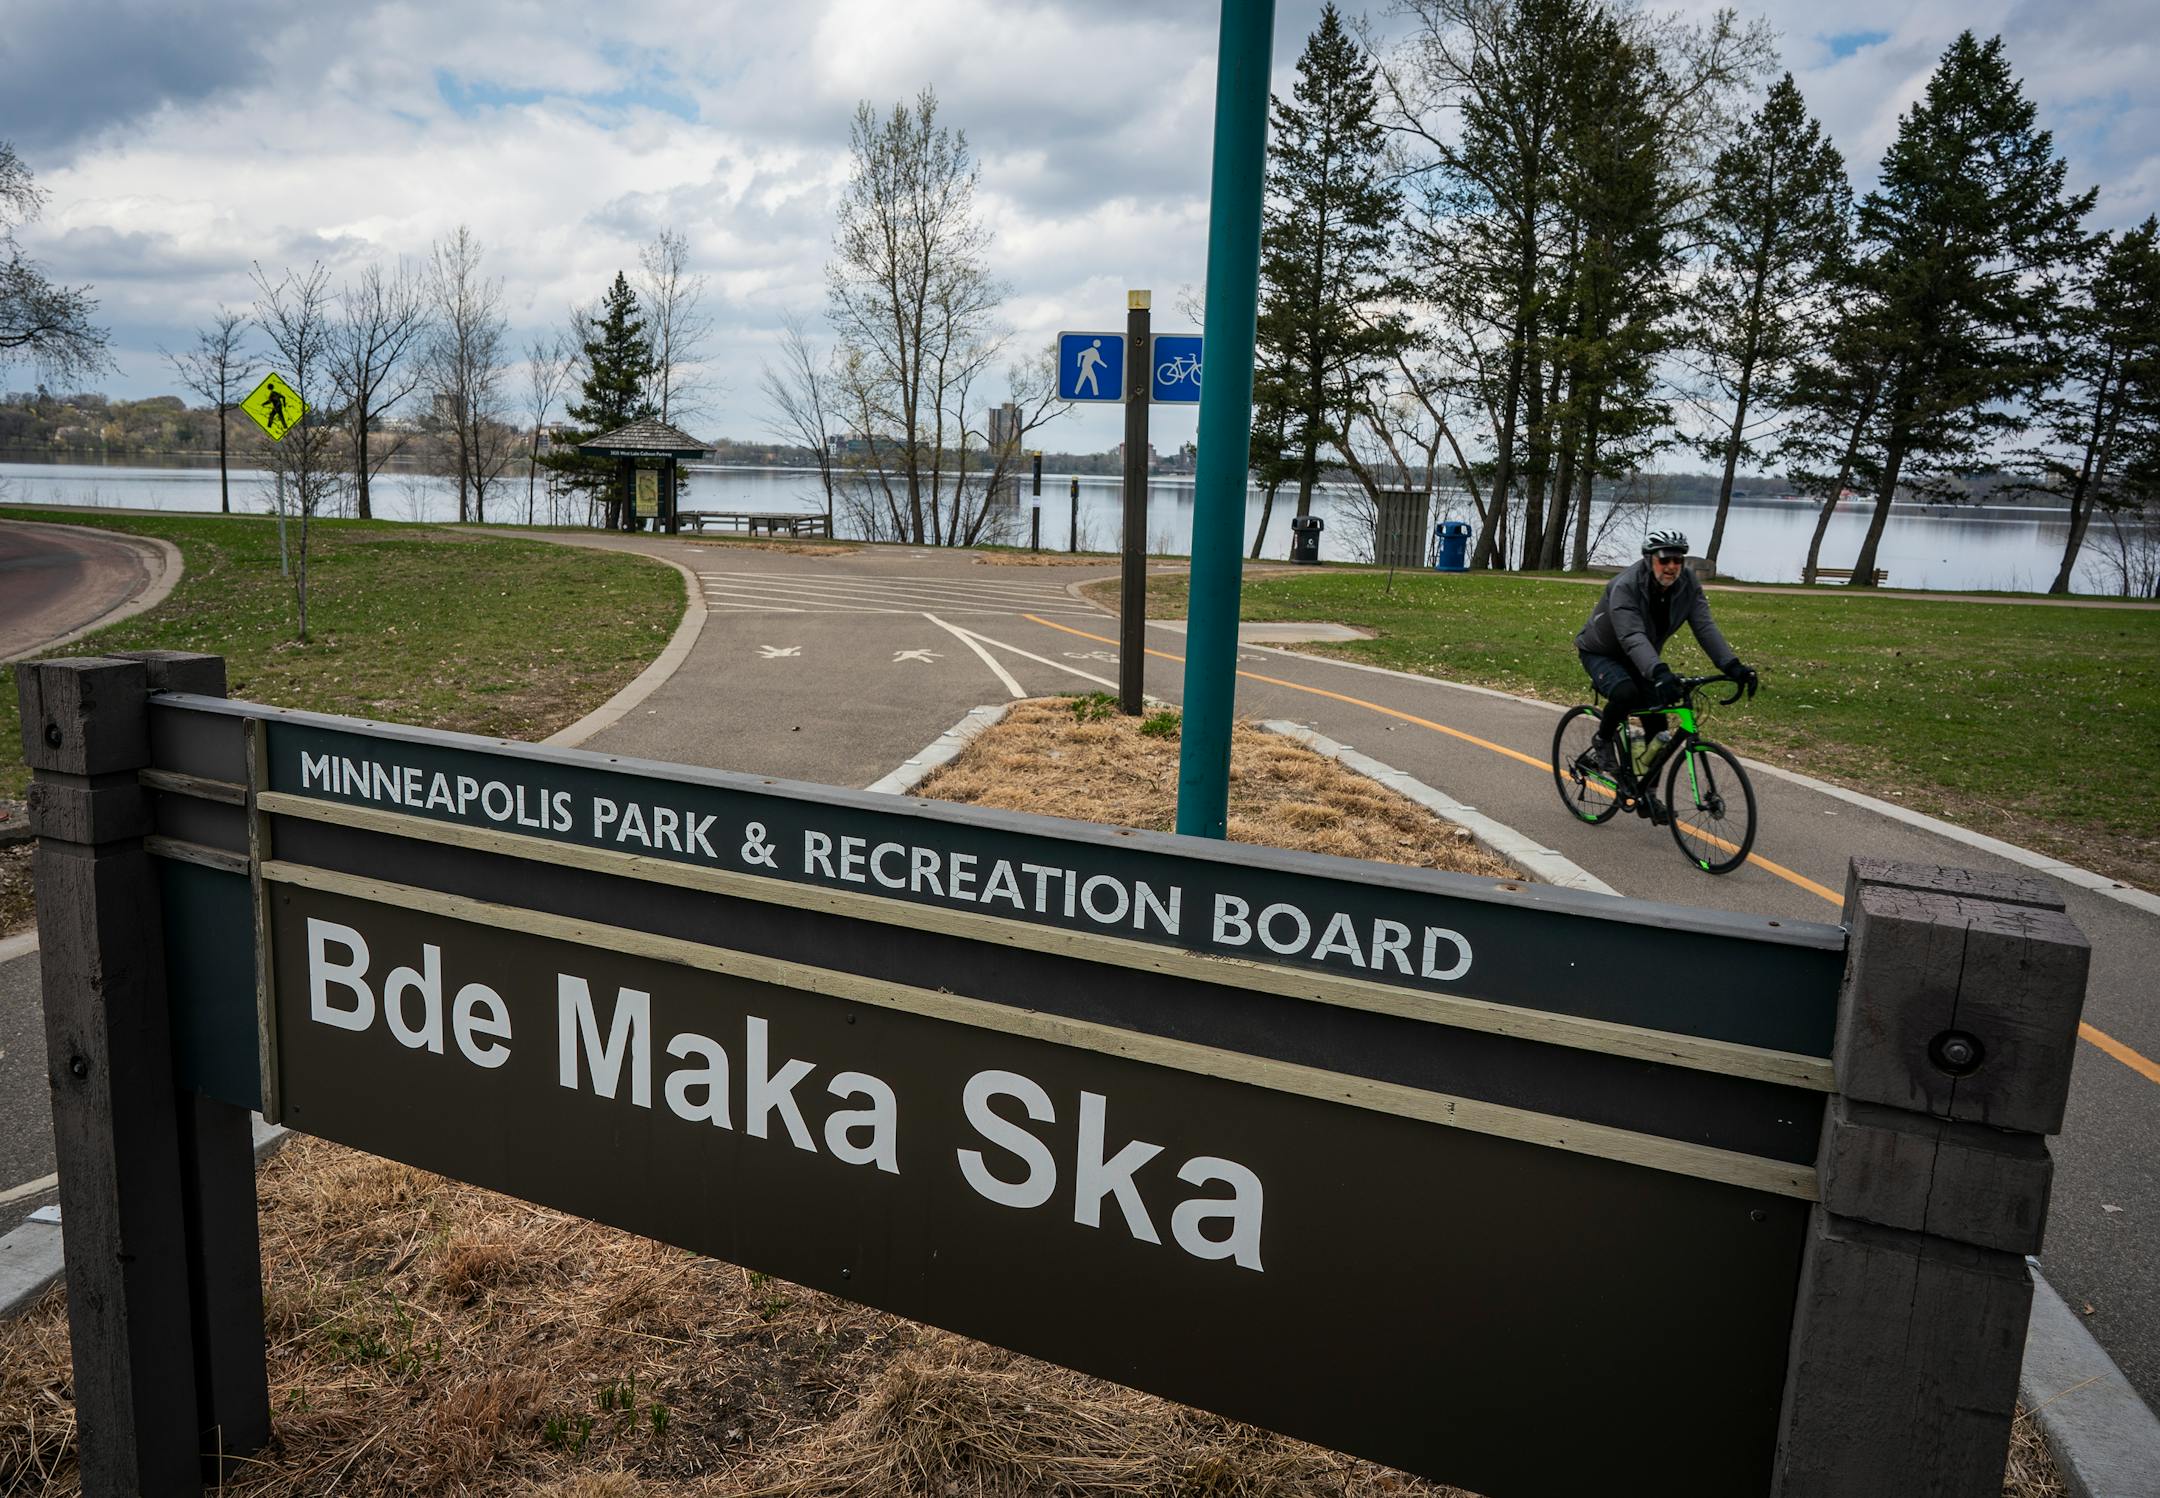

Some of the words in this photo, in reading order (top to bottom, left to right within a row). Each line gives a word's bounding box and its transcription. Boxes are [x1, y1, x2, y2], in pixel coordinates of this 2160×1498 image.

[301, 750, 573, 833] MINNEAPOLIS
[593, 796, 719, 859] PARK
[740, 821, 779, 869] &
[804, 829, 1183, 936] RECREATION
[1212, 893, 1474, 981] BOARD
[307, 916, 513, 1069] Bde
[557, 972, 902, 1176] Maka
[956, 1069, 1266, 1273] Ska
